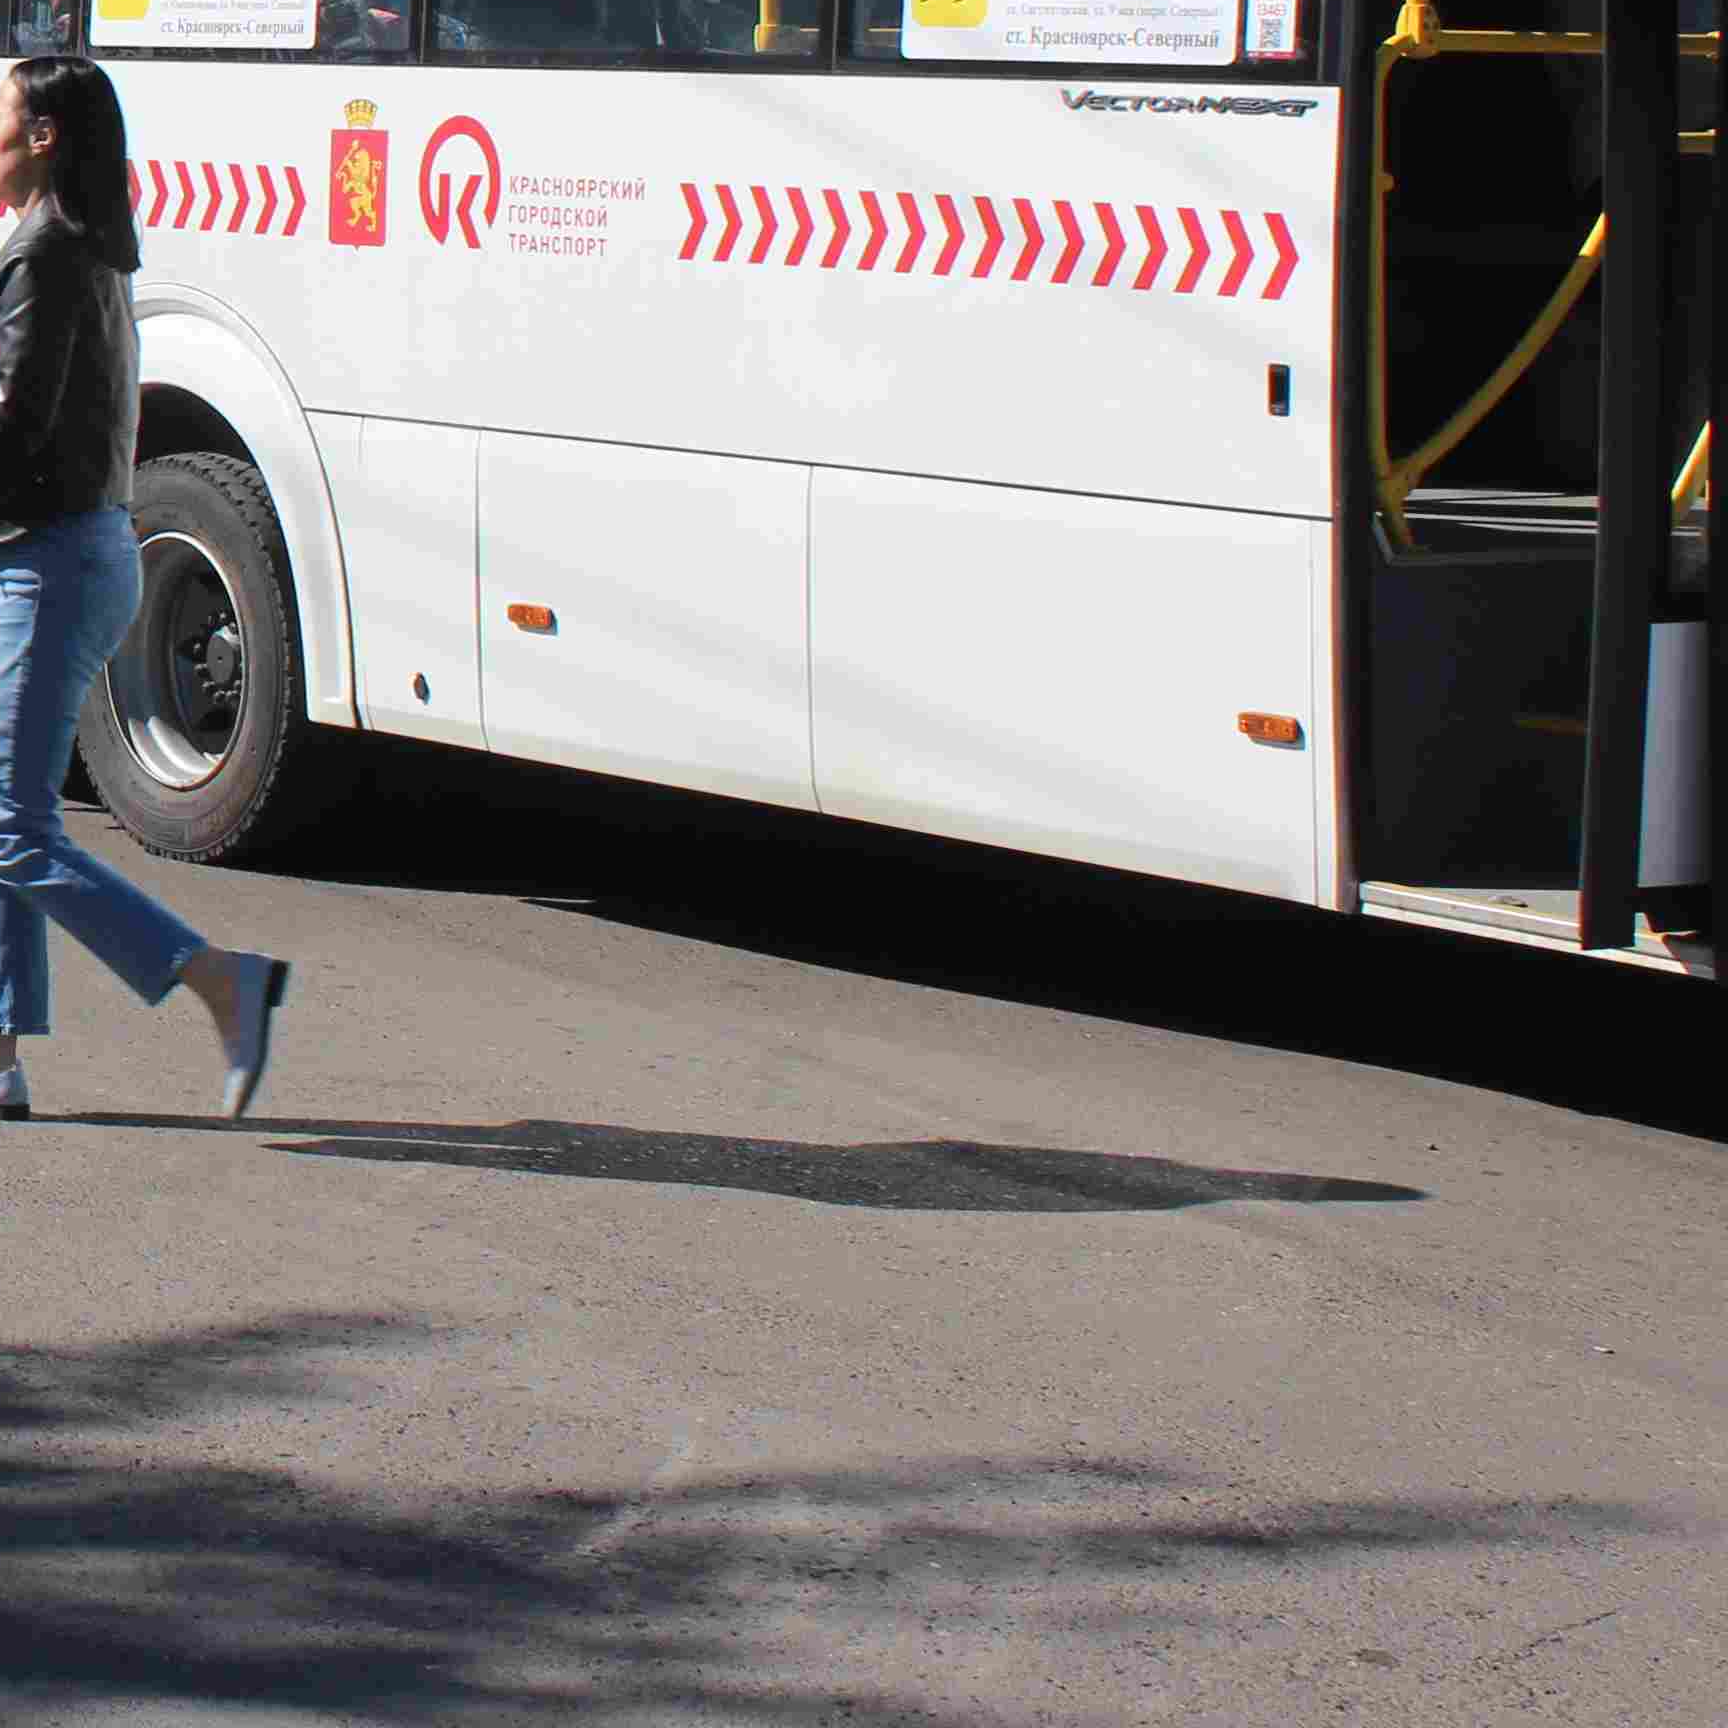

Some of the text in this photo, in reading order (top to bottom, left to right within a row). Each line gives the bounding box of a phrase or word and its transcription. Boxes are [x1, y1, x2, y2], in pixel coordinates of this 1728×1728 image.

[177, 17, 305, 39] Красноярск-Северный
[1030, 26, 1221, 54] Красноярск-Северный
[509, 175, 646, 201] КРАСНОЯРСКИЙ
[507, 204, 609, 229] ГОРОДСКОЙ
[508, 233, 609, 257] ТРАНСПОРТ
